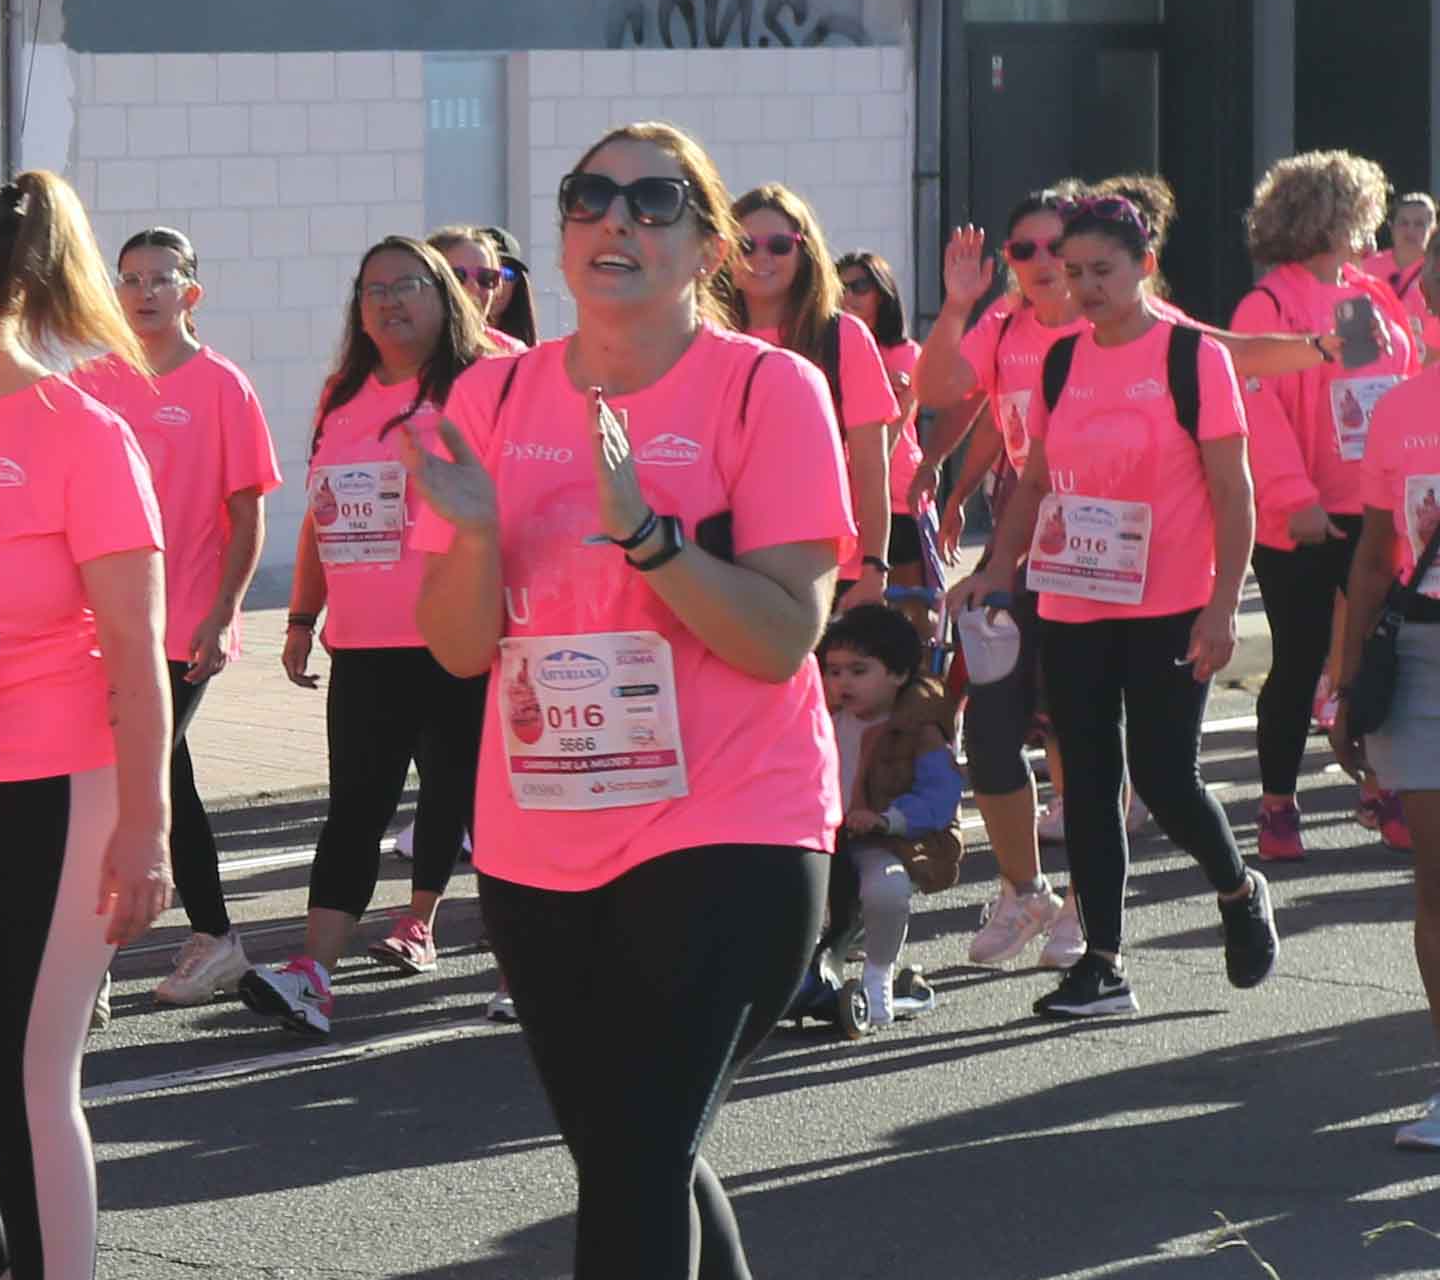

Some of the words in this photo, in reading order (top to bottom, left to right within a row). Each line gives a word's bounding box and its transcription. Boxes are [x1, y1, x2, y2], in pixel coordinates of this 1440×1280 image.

[341, 503, 374, 518] 016
[1070, 536, 1108, 554] 016
[547, 704, 605, 729] 016
